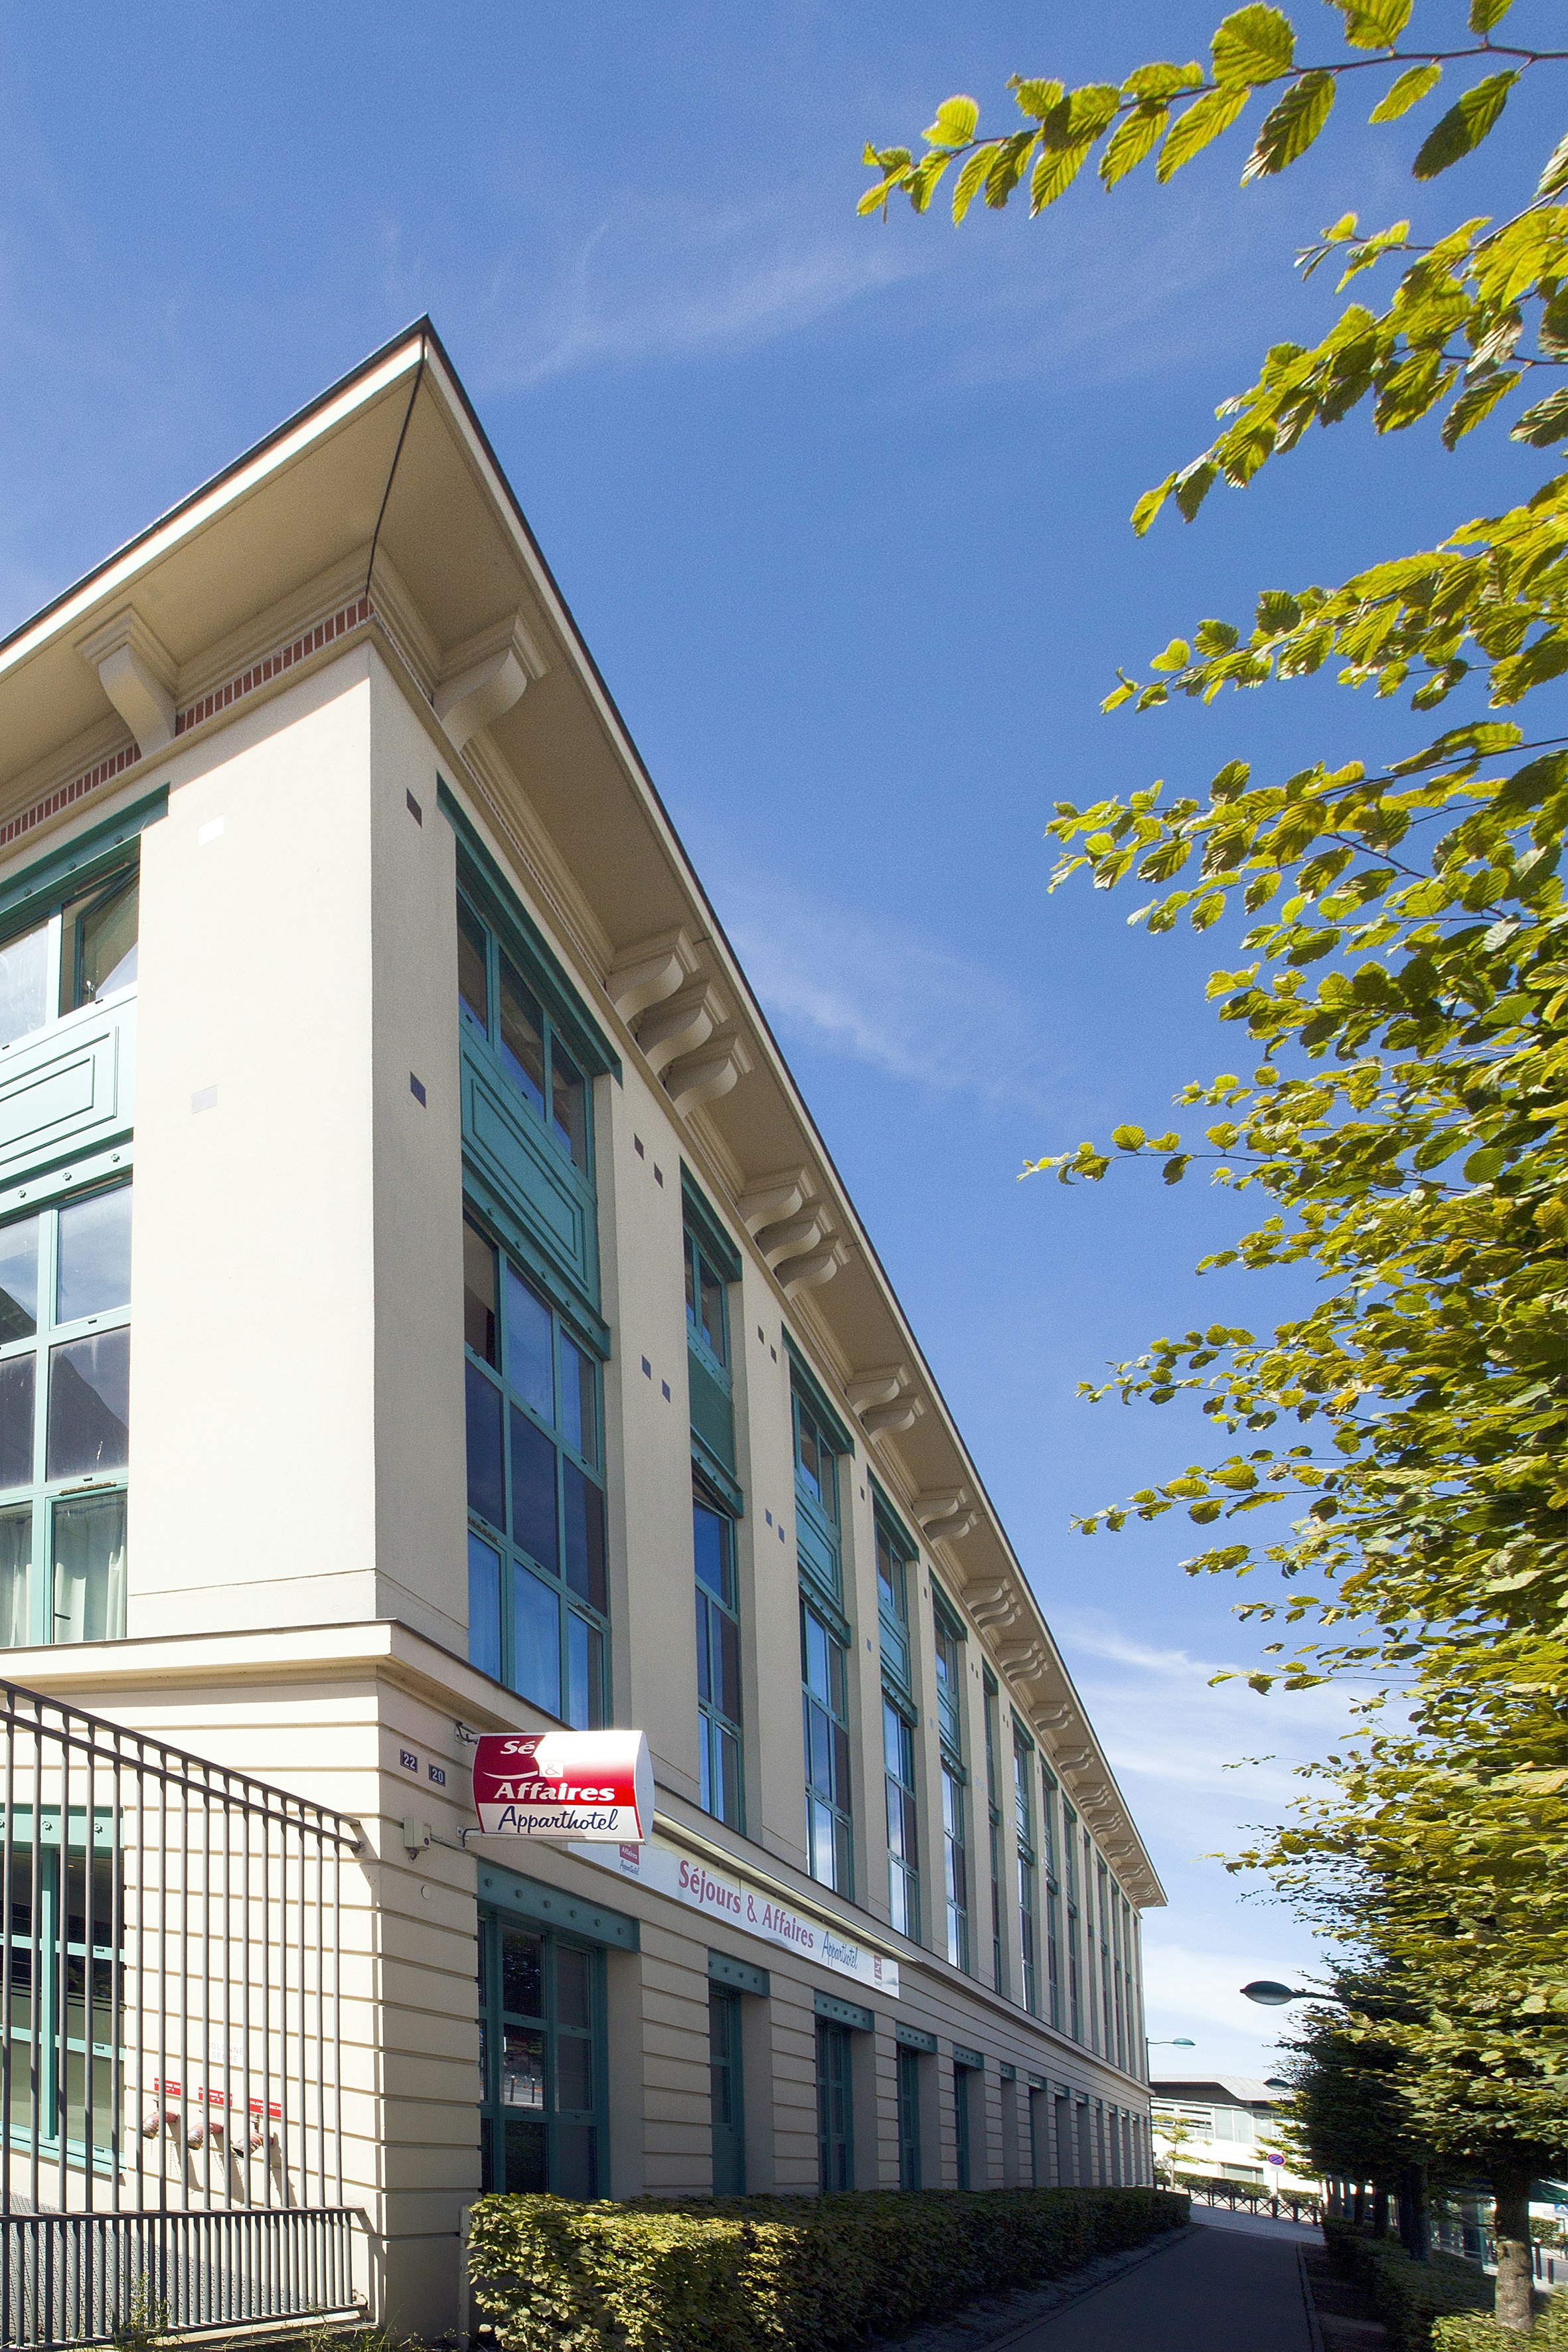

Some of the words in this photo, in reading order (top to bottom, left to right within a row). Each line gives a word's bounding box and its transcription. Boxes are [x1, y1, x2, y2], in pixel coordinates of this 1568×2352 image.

[404, 1753, 416, 1769] 22
[545, 1763, 560, 1775] &
[432, 1768, 443, 1782] 20
[493, 1782, 615, 1801] Affaires
[498, 1806, 619, 1834] Apparthotel
[621, 1847, 638, 1859] Affaires
[678, 1860, 741, 1913] Séjours
[747, 1895, 757, 1923] &
[762, 1904, 814, 1948] Affaires
